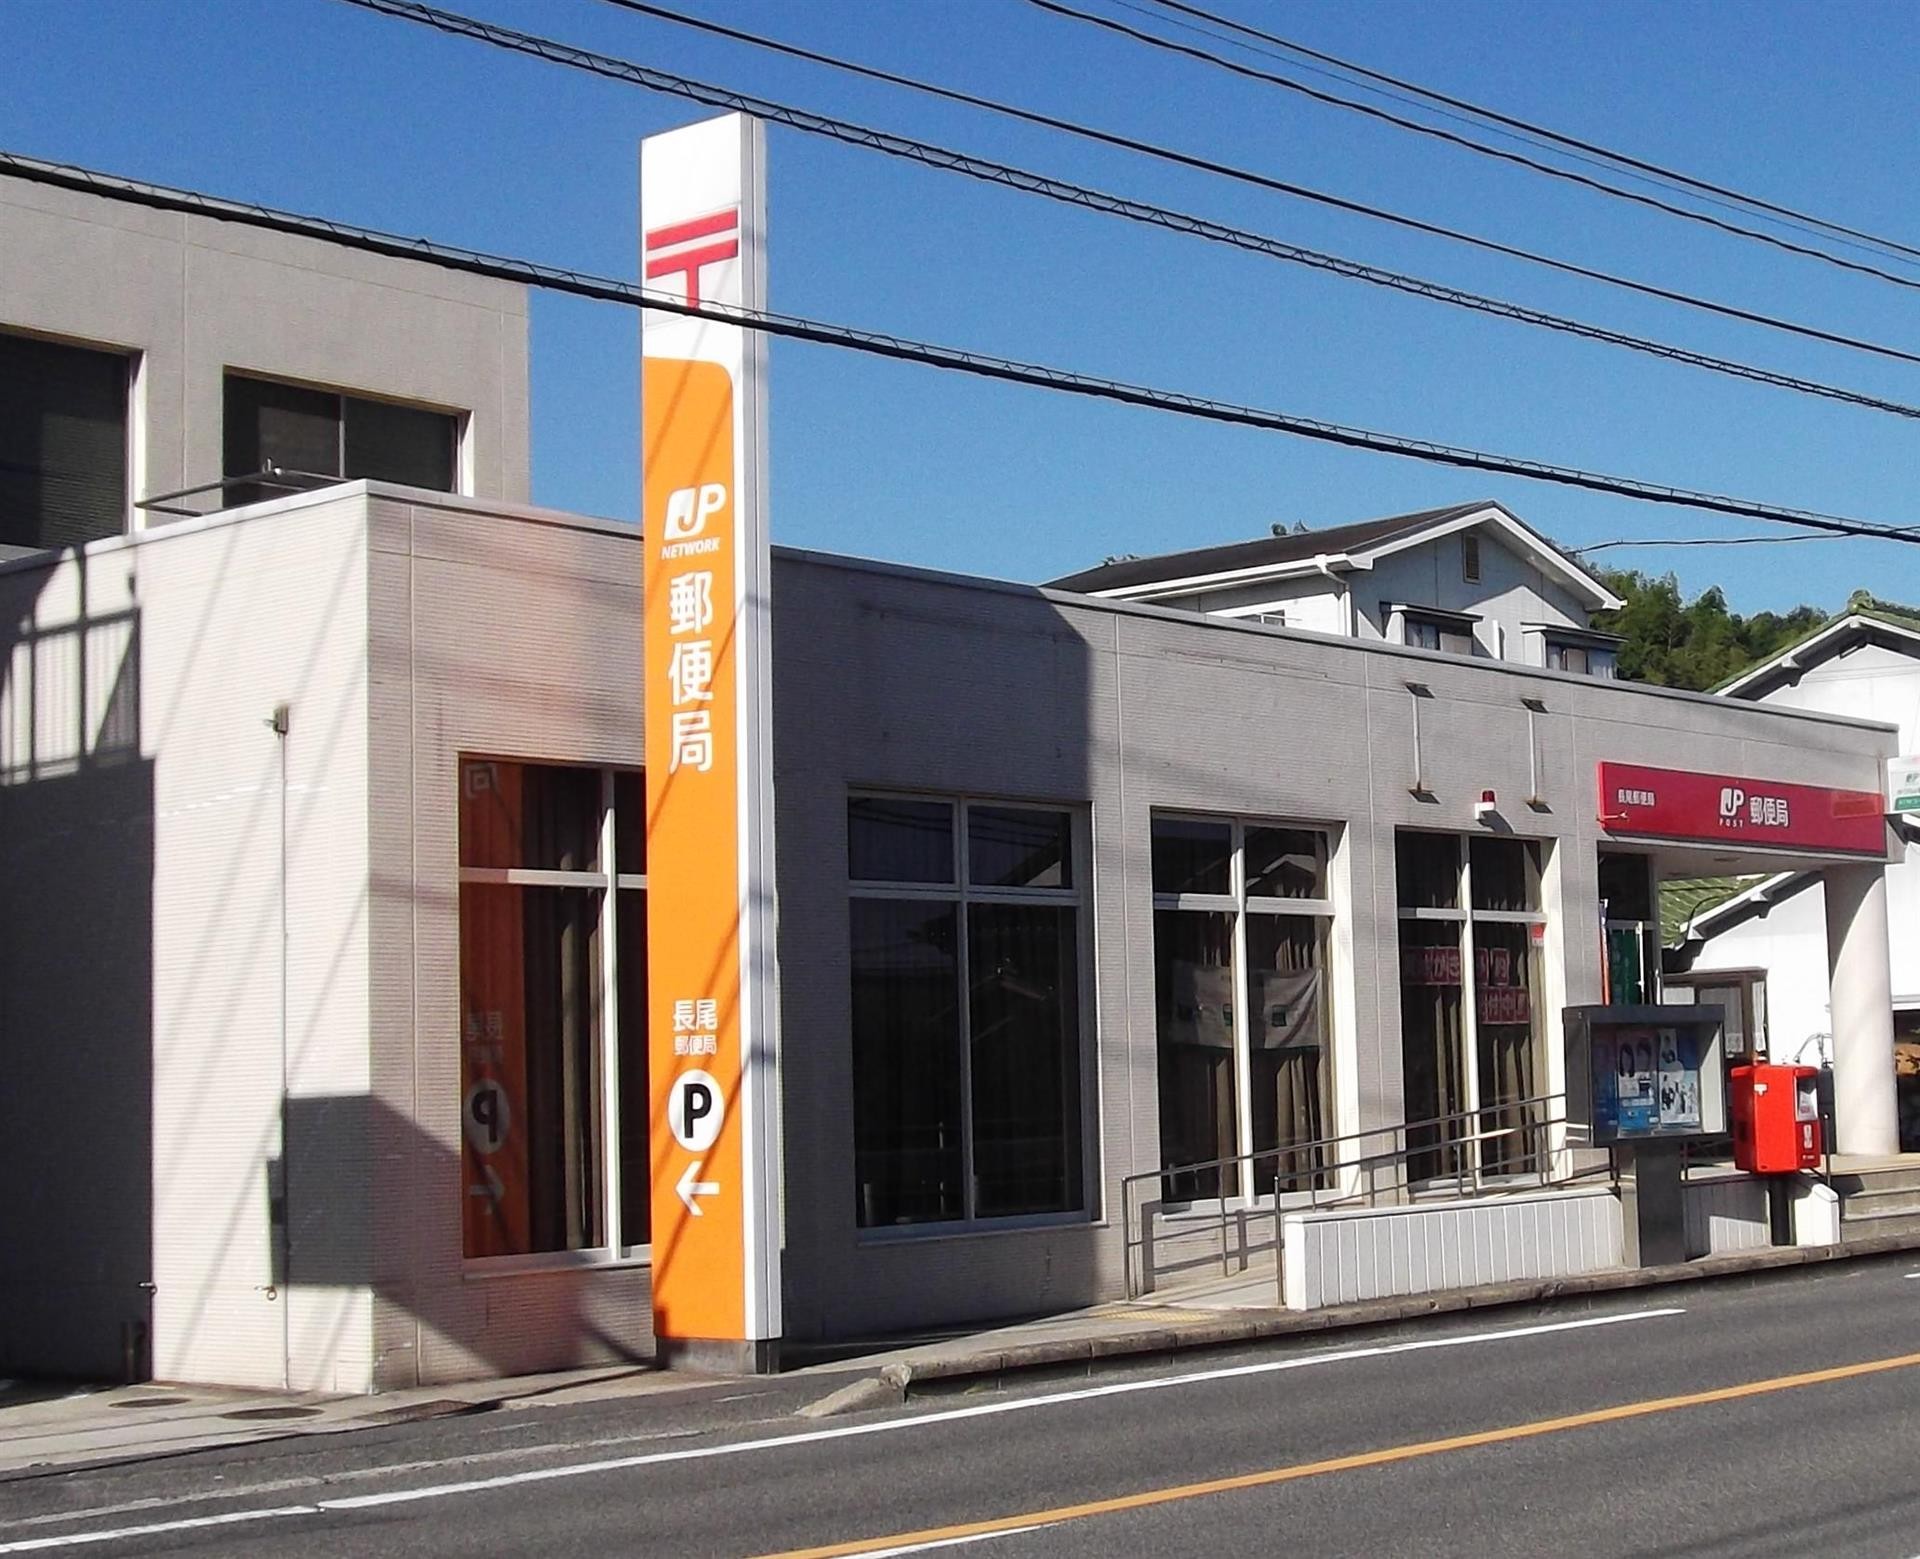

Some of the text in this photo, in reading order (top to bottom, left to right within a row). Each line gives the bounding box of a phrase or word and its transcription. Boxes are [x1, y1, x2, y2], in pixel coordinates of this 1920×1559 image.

[664, 484, 726, 540] JP
[661, 540, 719, 560] NETWORK
[669, 571, 714, 772] 郵便局
[1719, 787, 1744, 816] JP
[1749, 796, 1789, 828] 郵便局
[1719, 817, 1744, 828] POST
[674, 1000, 717, 1031] 長尾
[674, 1036, 716, 1055] 郵便局
[684, 1084, 712, 1138] P
